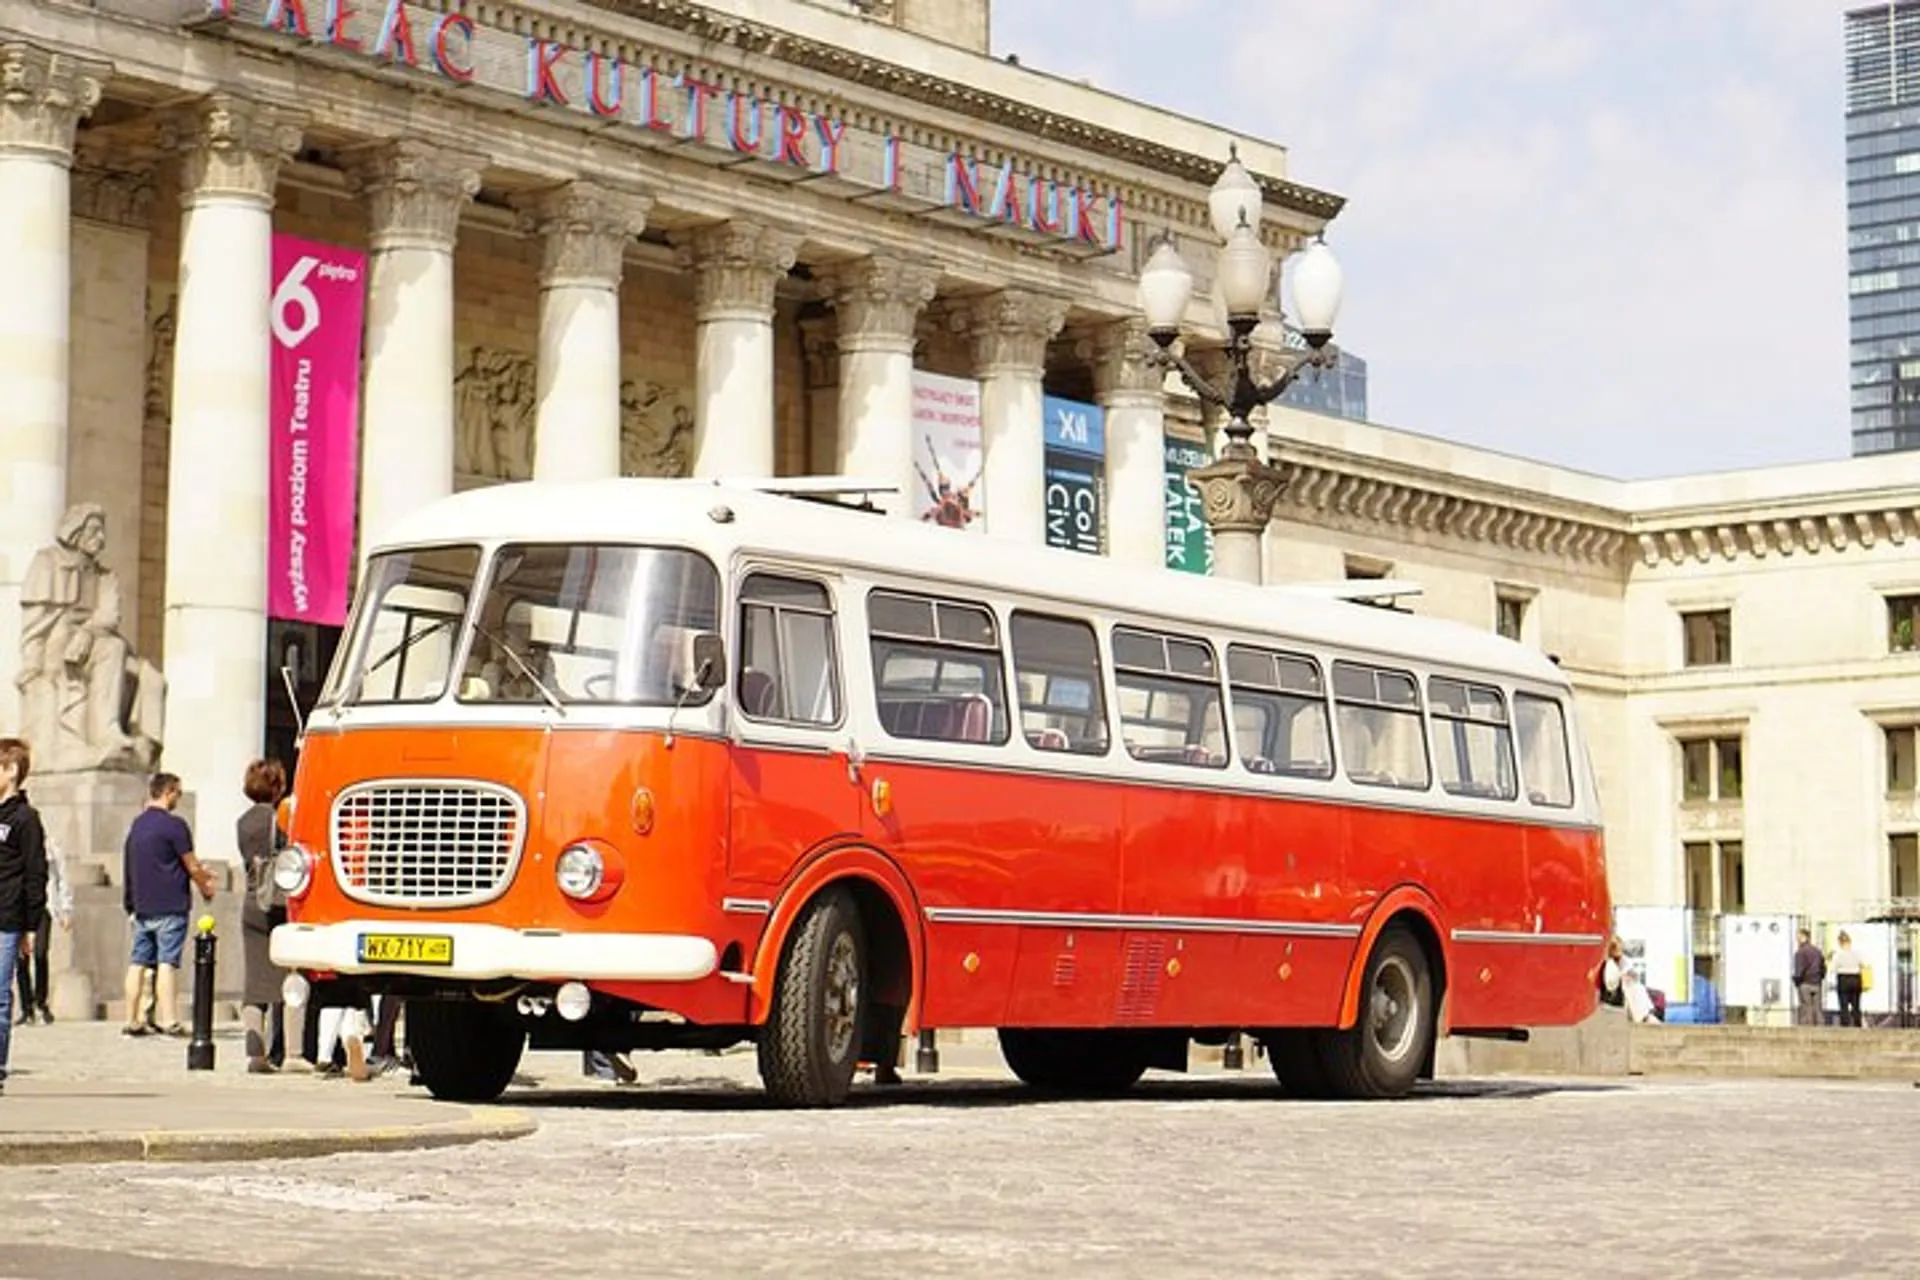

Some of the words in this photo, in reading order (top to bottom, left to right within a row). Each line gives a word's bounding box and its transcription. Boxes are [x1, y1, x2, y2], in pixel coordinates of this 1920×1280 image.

[211, 0, 474, 82] AŁAC
[527, 34, 846, 174] KULTURY
[884, 130, 900, 192] I
[946, 152, 1124, 250] NAUKI
[270, 255, 321, 350] 6
[290, 358, 312, 434] Teatru
[289, 439, 309, 526] poziom
